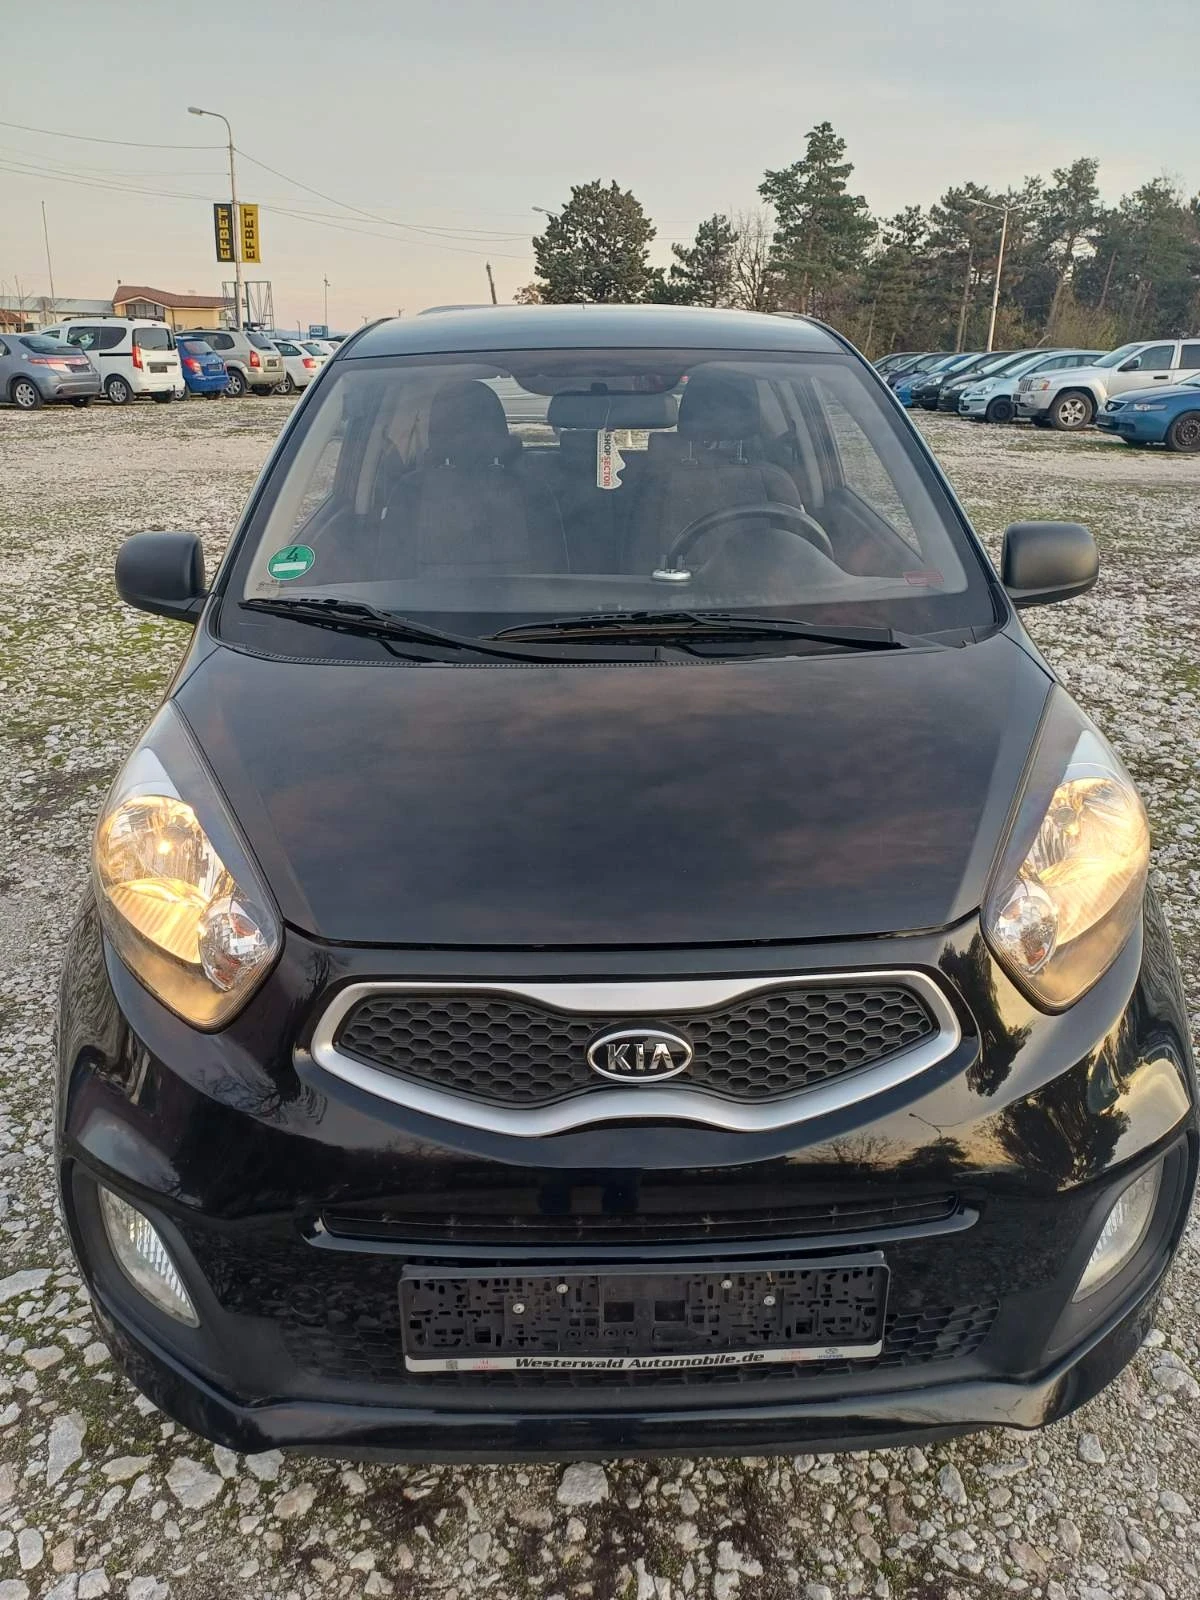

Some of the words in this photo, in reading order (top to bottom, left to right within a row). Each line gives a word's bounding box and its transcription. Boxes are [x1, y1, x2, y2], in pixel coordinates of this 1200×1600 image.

[218, 207, 231, 259] EFBET
[244, 208, 255, 259] EFBET
[286, 546, 299, 562] 4
[606, 1043, 675, 1070] KIA
[515, 1358, 624, 1369] Westerwald
[628, 1353, 765, 1369] Automobile.de
